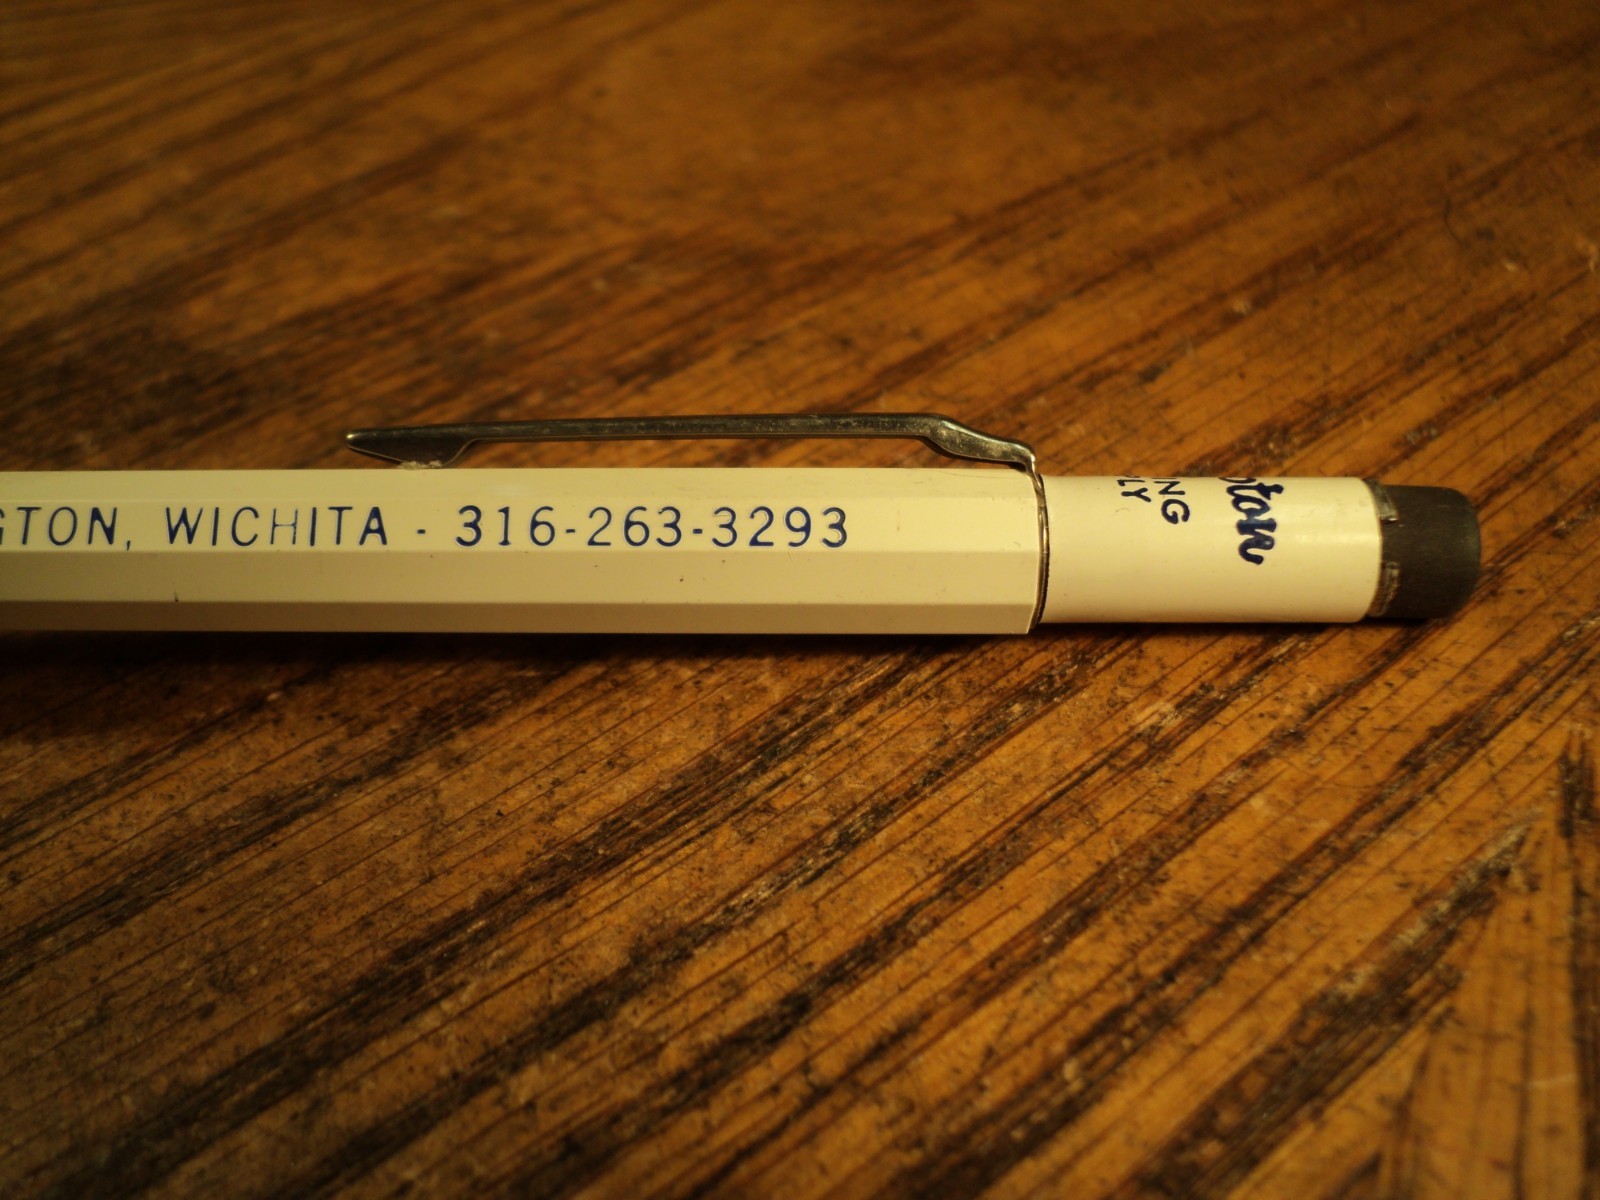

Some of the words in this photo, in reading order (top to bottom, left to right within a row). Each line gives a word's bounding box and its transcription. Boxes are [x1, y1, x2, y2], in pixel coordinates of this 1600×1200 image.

[1115, 475, 1152, 503] LY
[0, 506, 131, 552] TON,
[164, 505, 388, 548] WICHITA
[456, 504, 848, 549] 316-263-3293
[1219, 476, 1285, 566] ton
